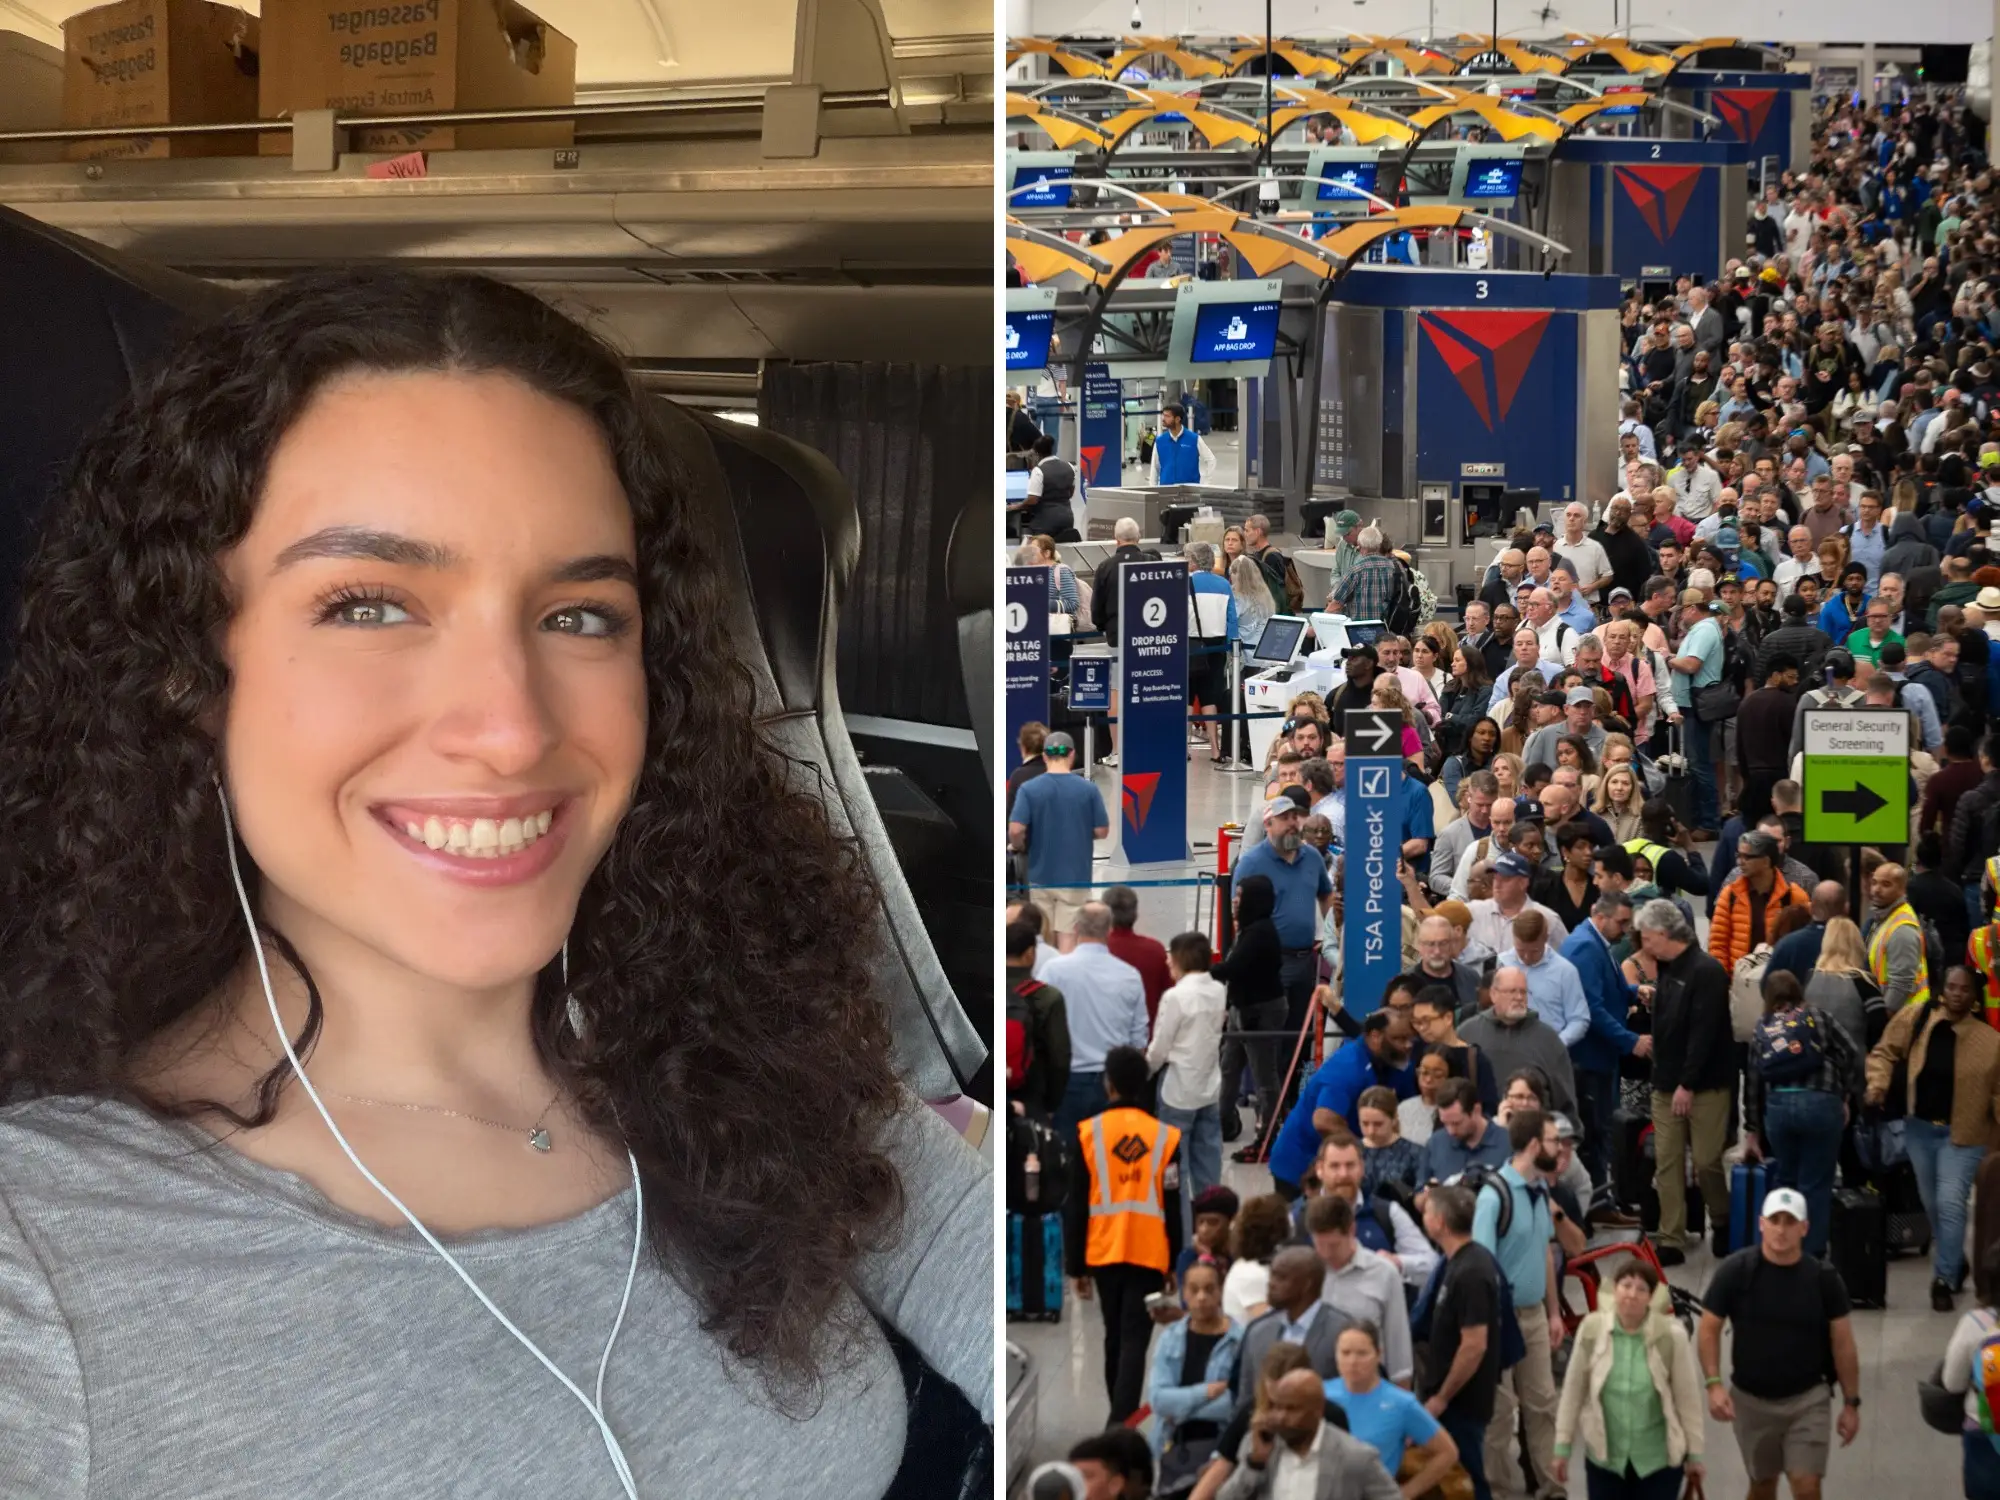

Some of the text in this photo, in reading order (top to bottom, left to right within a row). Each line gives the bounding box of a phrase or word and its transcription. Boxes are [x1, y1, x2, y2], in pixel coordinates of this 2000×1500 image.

[1651, 144, 1661, 158] 2
[1267, 282, 1277, 291] 84
[1475, 280, 1489, 299] 3
[1213, 342, 1256, 352] APP BAG DROP
[1011, 351, 1029, 360] DROP
[1140, 571, 1173, 581] DELTA
[1011, 609, 1018, 627] 1
[1149, 603, 1160, 622] 2
[1022, 640, 1041, 650] TAG
[1131, 634, 1178, 647] DROP BAGS
[1016, 651, 1040, 661] BAGS
[1138, 646, 1171, 657] WITH ID
[1143, 669, 1164, 677] ACCESS:
[1811, 719, 1902, 735] General Security
[1828, 737, 1884, 753] Screening
[1365, 810, 1384, 965] TSA PreCheck
